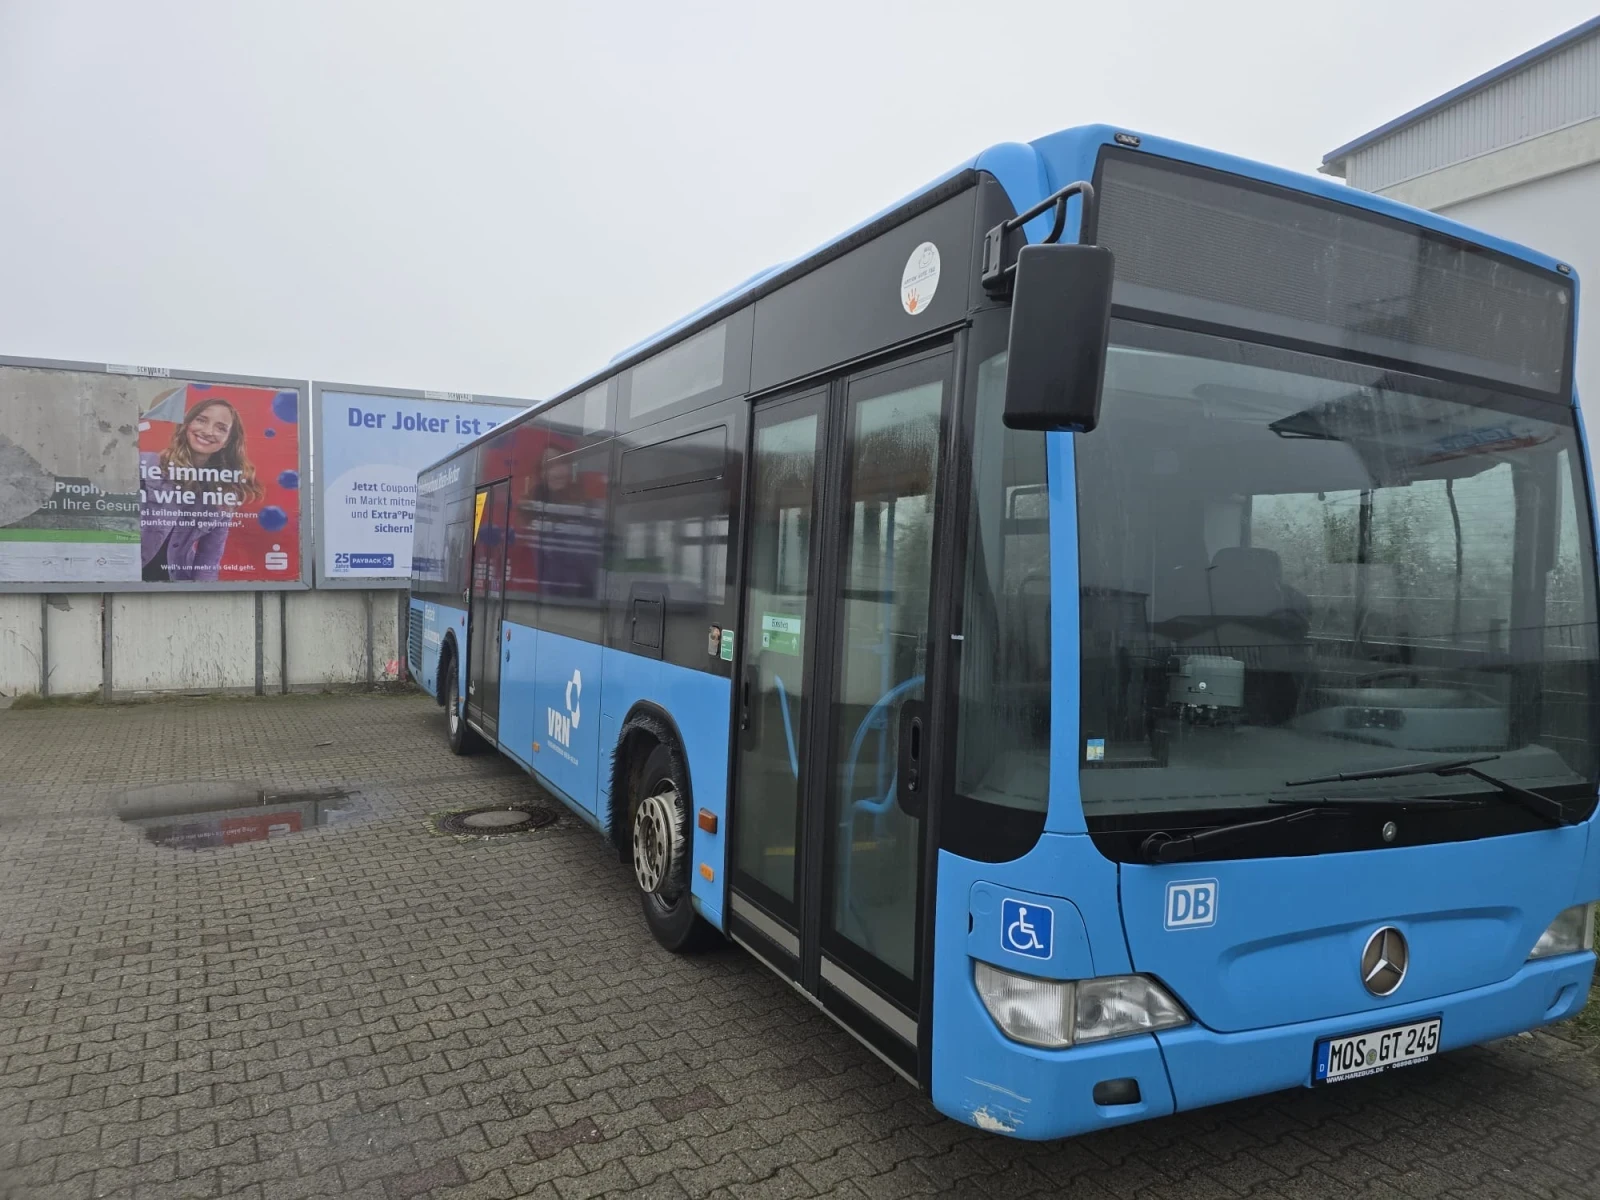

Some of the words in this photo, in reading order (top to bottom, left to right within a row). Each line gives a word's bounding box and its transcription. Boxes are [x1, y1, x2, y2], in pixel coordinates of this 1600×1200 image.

[348, 408, 386, 429] Der
[392, 411, 450, 434] Joker
[456, 415, 482, 436] ist
[168, 461, 247, 484] immer.
[352, 482, 378, 492] Jetzt
[153, 485, 196, 505] wie
[202, 486, 243, 507] nie.
[345, 495, 357, 505] im
[360, 496, 387, 506] Markt
[63, 498, 91, 511] Ihre
[95, 499, 140, 512] Gesun
[152, 509, 219, 519] teilnehmenden
[221, 510, 258, 519] Partnern
[351, 509, 369, 519] und
[140, 519, 177, 528] punkten
[178, 519, 196, 527] und
[374, 523, 413, 534] sichern!
[334, 553, 350, 564] 25
[239, 564, 256, 572] geht.
[547, 706, 571, 748] VRN
[1171, 887, 1211, 922] DB
[1319, 1063, 1325, 1073] D
[1329, 1039, 1367, 1073] MOS
[1379, 1031, 1403, 1062] GT
[1405, 1023, 1438, 1056] 245
